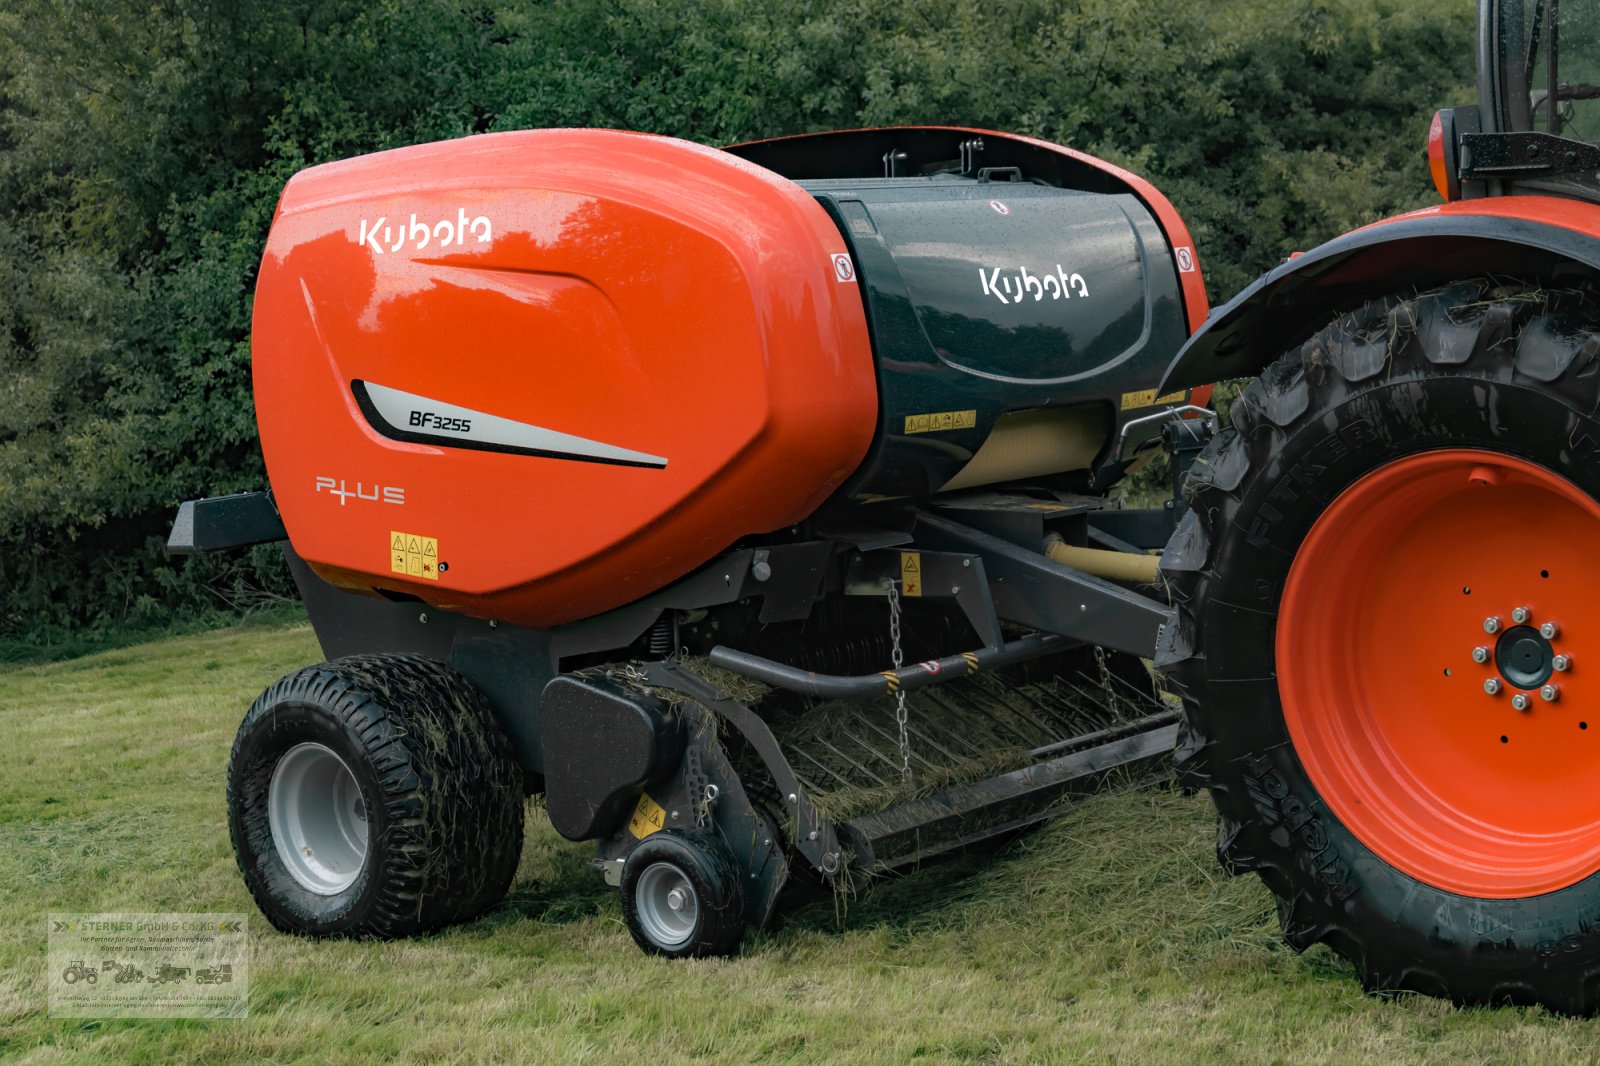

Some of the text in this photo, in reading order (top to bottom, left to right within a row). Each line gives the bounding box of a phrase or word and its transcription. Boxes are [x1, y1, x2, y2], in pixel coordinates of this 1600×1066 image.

[359, 208, 492, 253] Kubota
[979, 264, 1089, 305] Kubota
[409, 410, 471, 433] BF3255
